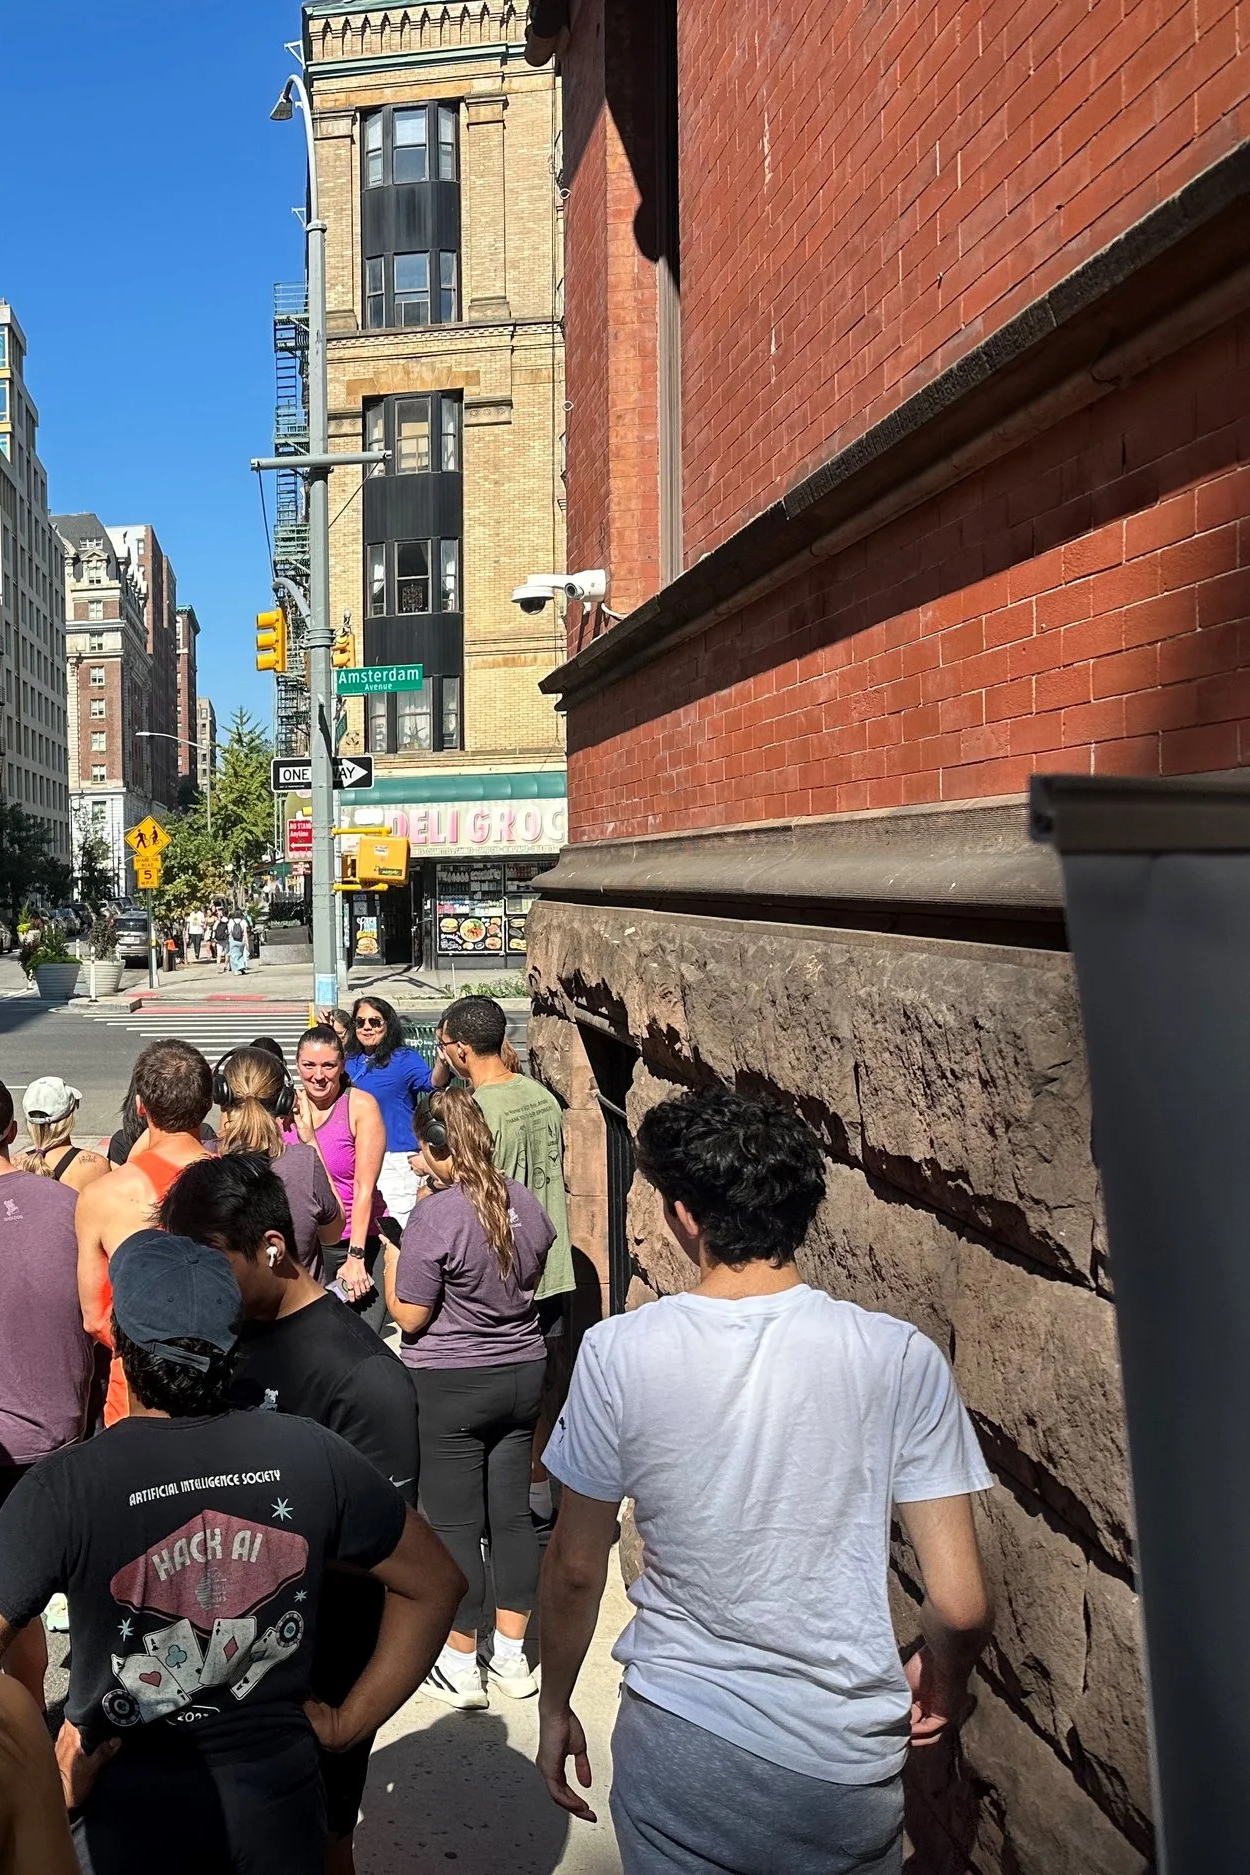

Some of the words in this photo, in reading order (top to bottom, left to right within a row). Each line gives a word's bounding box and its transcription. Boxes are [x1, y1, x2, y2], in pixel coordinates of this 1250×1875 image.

[338, 668, 419, 685] Amsterdam
[364, 683, 393, 691] Avenue
[283, 768, 310, 781] ONE
[385, 808, 461, 845] DELI
[465, 803, 565, 844] GROC
[290, 830, 309, 838] Anytime
[144, 870, 152, 880] 5
[129, 1482, 179, 1506] ARTIFICIAL
[180, 1473, 240, 1493] INTELLIGENCE
[242, 1469, 281, 1485] SOCIETY
[151, 1528, 223, 1581] HACK
[231, 1530, 263, 1563] AI
